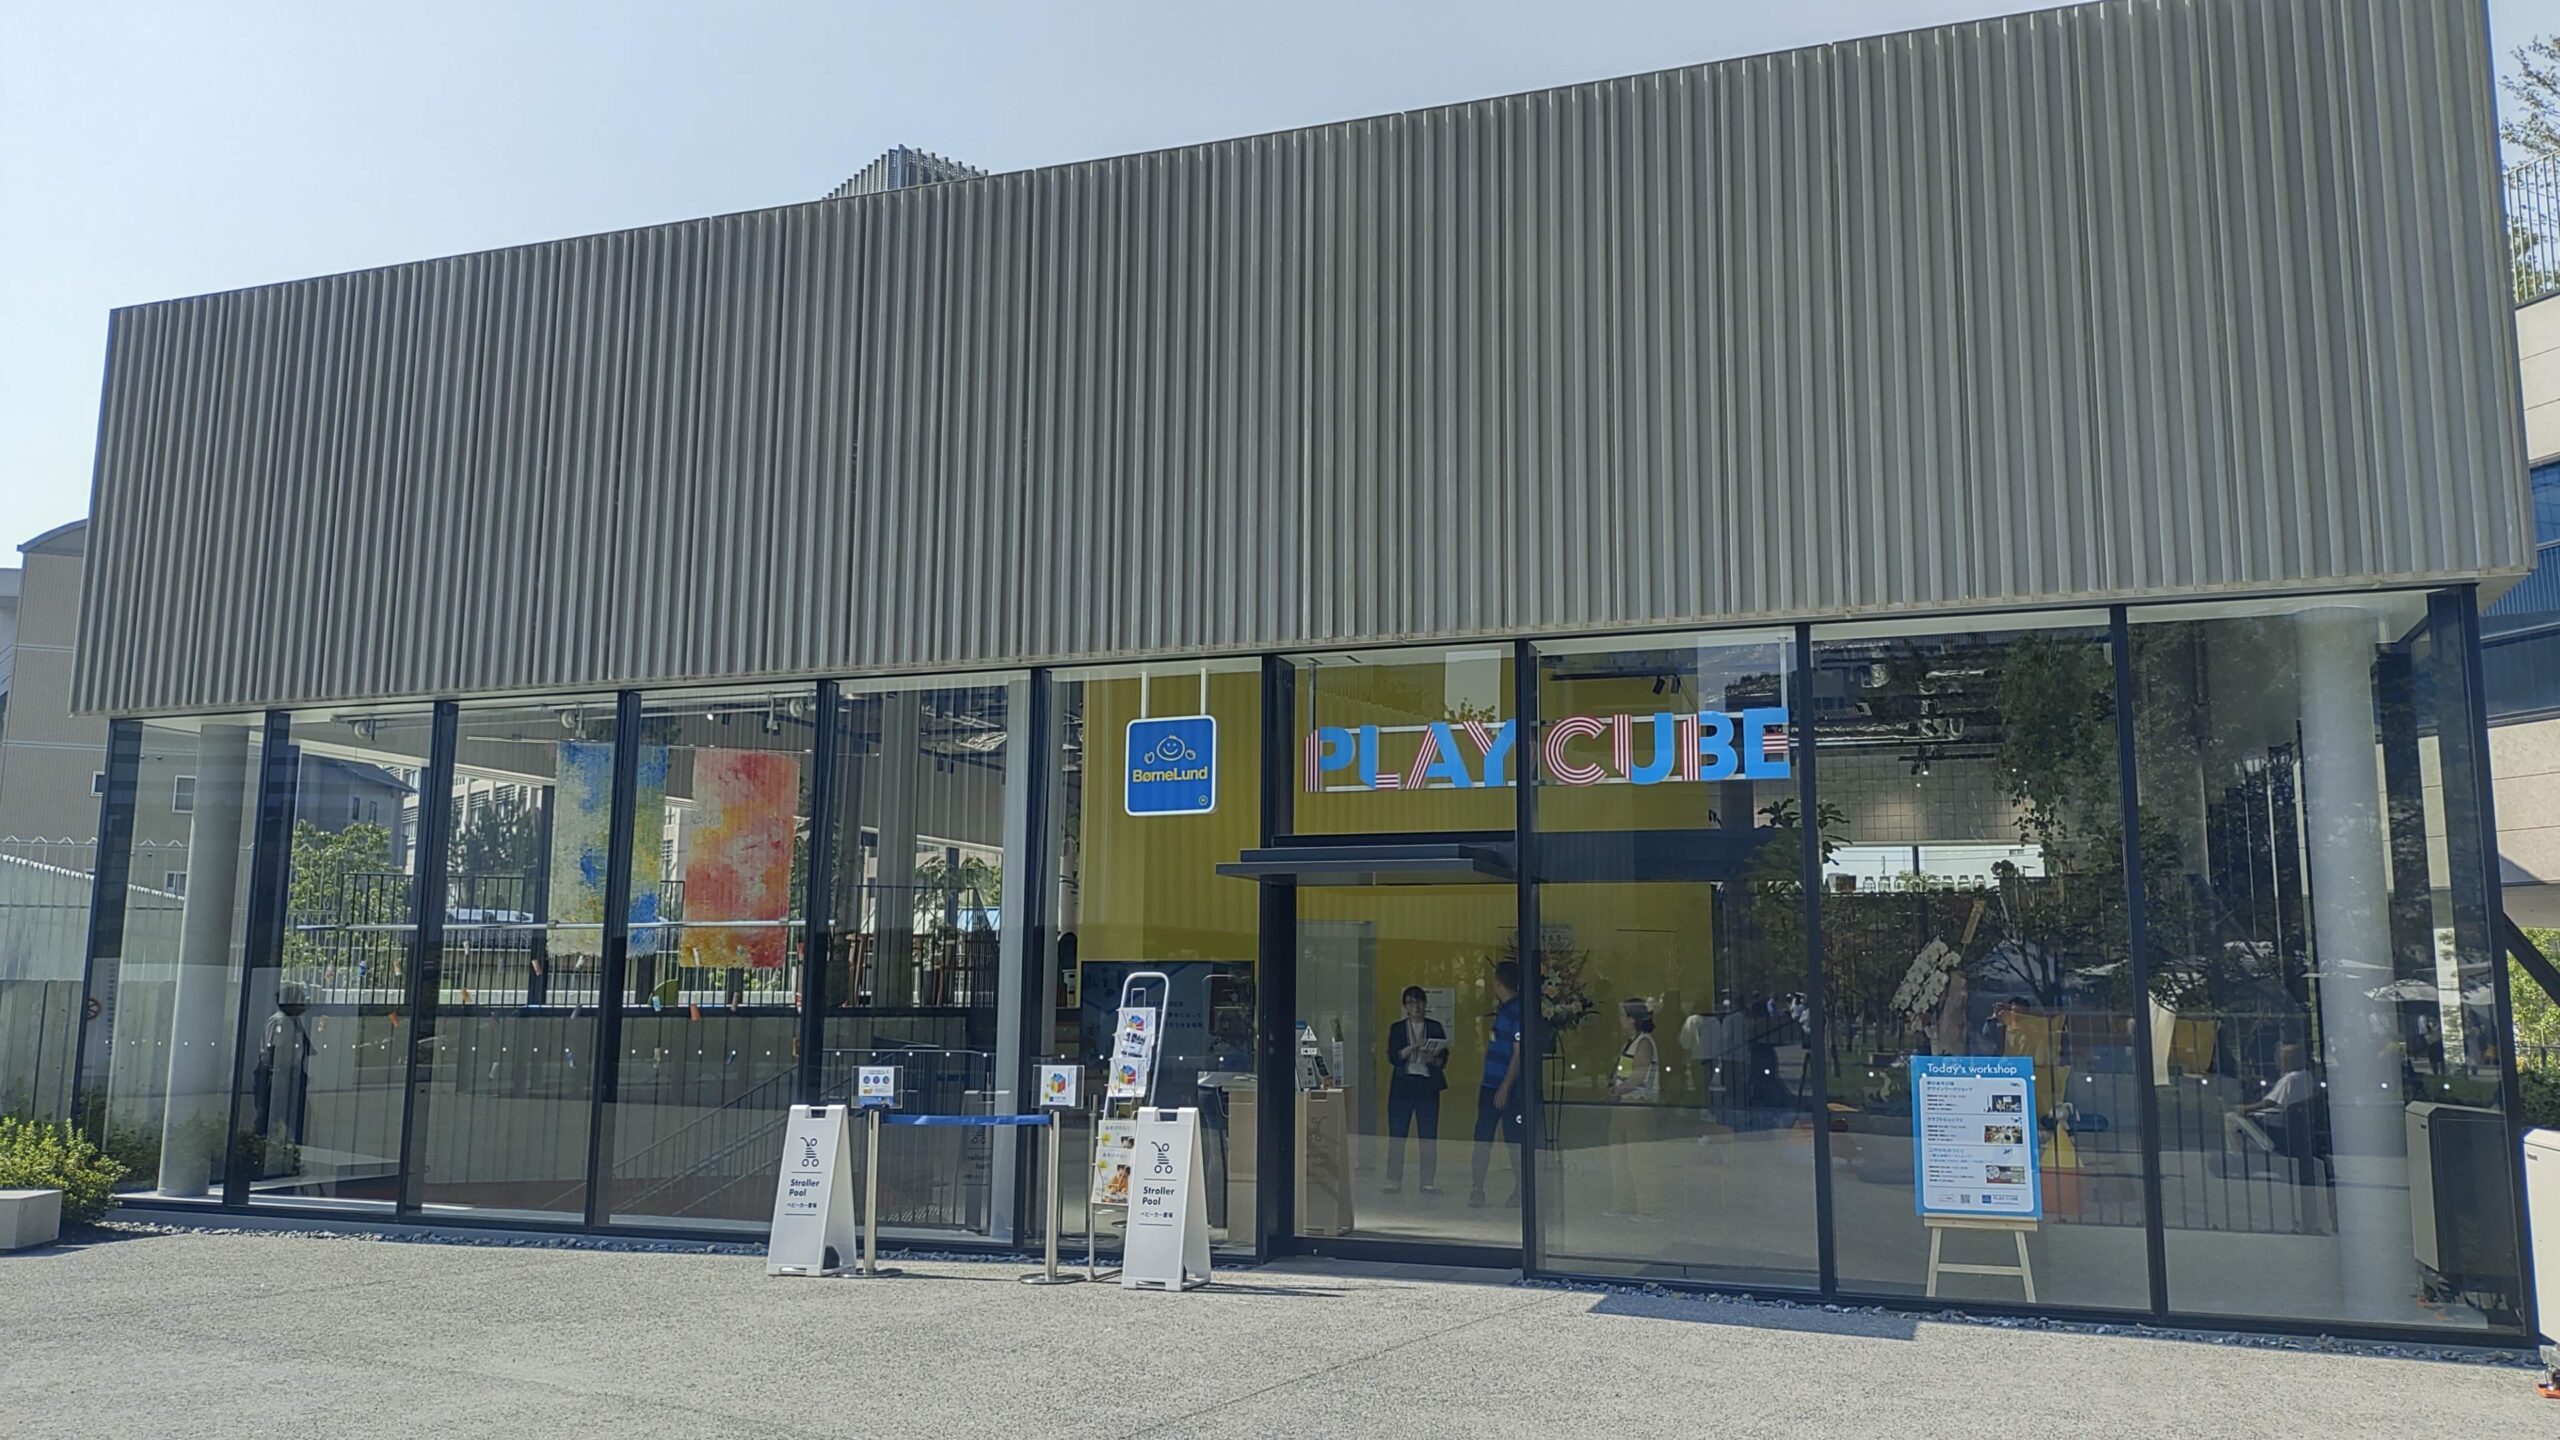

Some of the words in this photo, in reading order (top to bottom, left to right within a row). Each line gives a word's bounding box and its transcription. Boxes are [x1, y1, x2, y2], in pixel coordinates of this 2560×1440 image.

[1305, 718, 1516, 792] PLAY
[1544, 707, 1792, 786] CUBE
[1132, 766, 1208, 783] BørneLund
[1927, 1063, 1966, 1075] Today's
[1968, 1064, 2017, 1075] workshop
[790, 1179, 820, 1187] Stroller
[789, 1188, 806, 1196] Pool
[1143, 1186, 1175, 1195] Stroller
[1142, 1196, 1161, 1205] Pool
